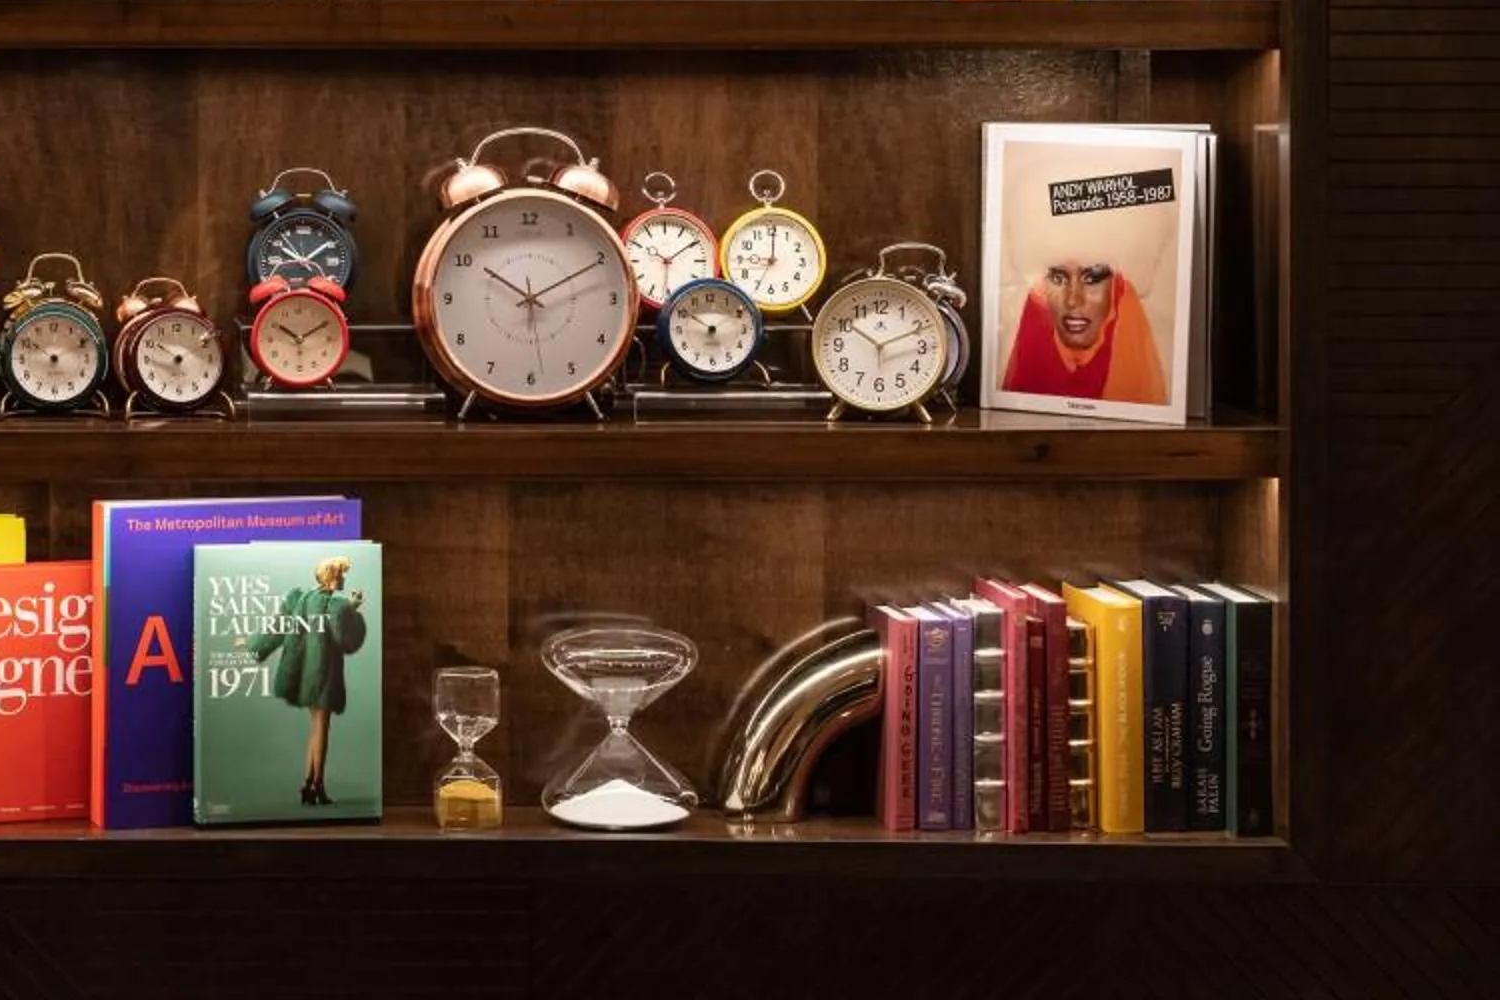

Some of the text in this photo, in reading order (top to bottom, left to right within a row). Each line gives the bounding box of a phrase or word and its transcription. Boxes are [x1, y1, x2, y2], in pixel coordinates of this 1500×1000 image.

[1052, 174, 1136, 199] ANDY WARHOL
[1052, 195, 1105, 214] Polaroids
[521, 213, 538, 225] 12
[482, 226, 499, 239] 11
[566, 223, 574, 237] 1
[752, 230, 763, 241] 11
[784, 231, 790, 242] 1
[741, 240, 753, 251] 10
[793, 242, 801, 253] 2
[455, 254, 473, 268] 10
[597, 251, 606, 264] 2
[736, 255, 744, 265] 9
[799, 257, 807, 268] 3
[741, 268, 749, 280] 8
[793, 271, 801, 281] 4
[767, 283, 775, 295] 6
[782, 281, 789, 292] 5
[443, 293, 453, 305] 9
[609, 293, 618, 305] 3
[854, 305, 868, 318] 11
[873, 301, 889, 315] 12
[899, 306, 905, 320] 1
[838, 319, 852, 333] 10
[912, 320, 923, 335] 2
[456, 333, 466, 346] 8
[596, 333, 606, 345] 4
[833, 337, 844, 352] 9
[917, 339, 927, 355] 3
[486, 362, 495, 375] 7
[567, 362, 576, 375] 5
[839, 358, 849, 372] 8
[909, 359, 920, 374] 4
[526, 373, 536, 386] 6
[855, 372, 865, 386] 7
[873, 378, 885, 393] 6
[894, 373, 905, 388] 5
[126, 512, 346, 533] The Metropolitan Museum of Art
[208, 575, 270, 596] YVES
[208, 595, 287, 616] SAINT
[209, 614, 332, 636] LAURENT
[125, 615, 184, 686] A
[207, 668, 273, 698] 1971
[901, 665, 916, 737] GOING
[1197, 654, 1218, 752] Going Rogue
[1151, 707, 1164, 729] AM
[1171, 701, 1184, 757] GRAHAM
[929, 692, 945, 804] THRONE FIRE
[1151, 737, 1164, 753] AS
[1197, 768, 1208, 815] SARAH
[1207, 772, 1220, 814] PALIN
